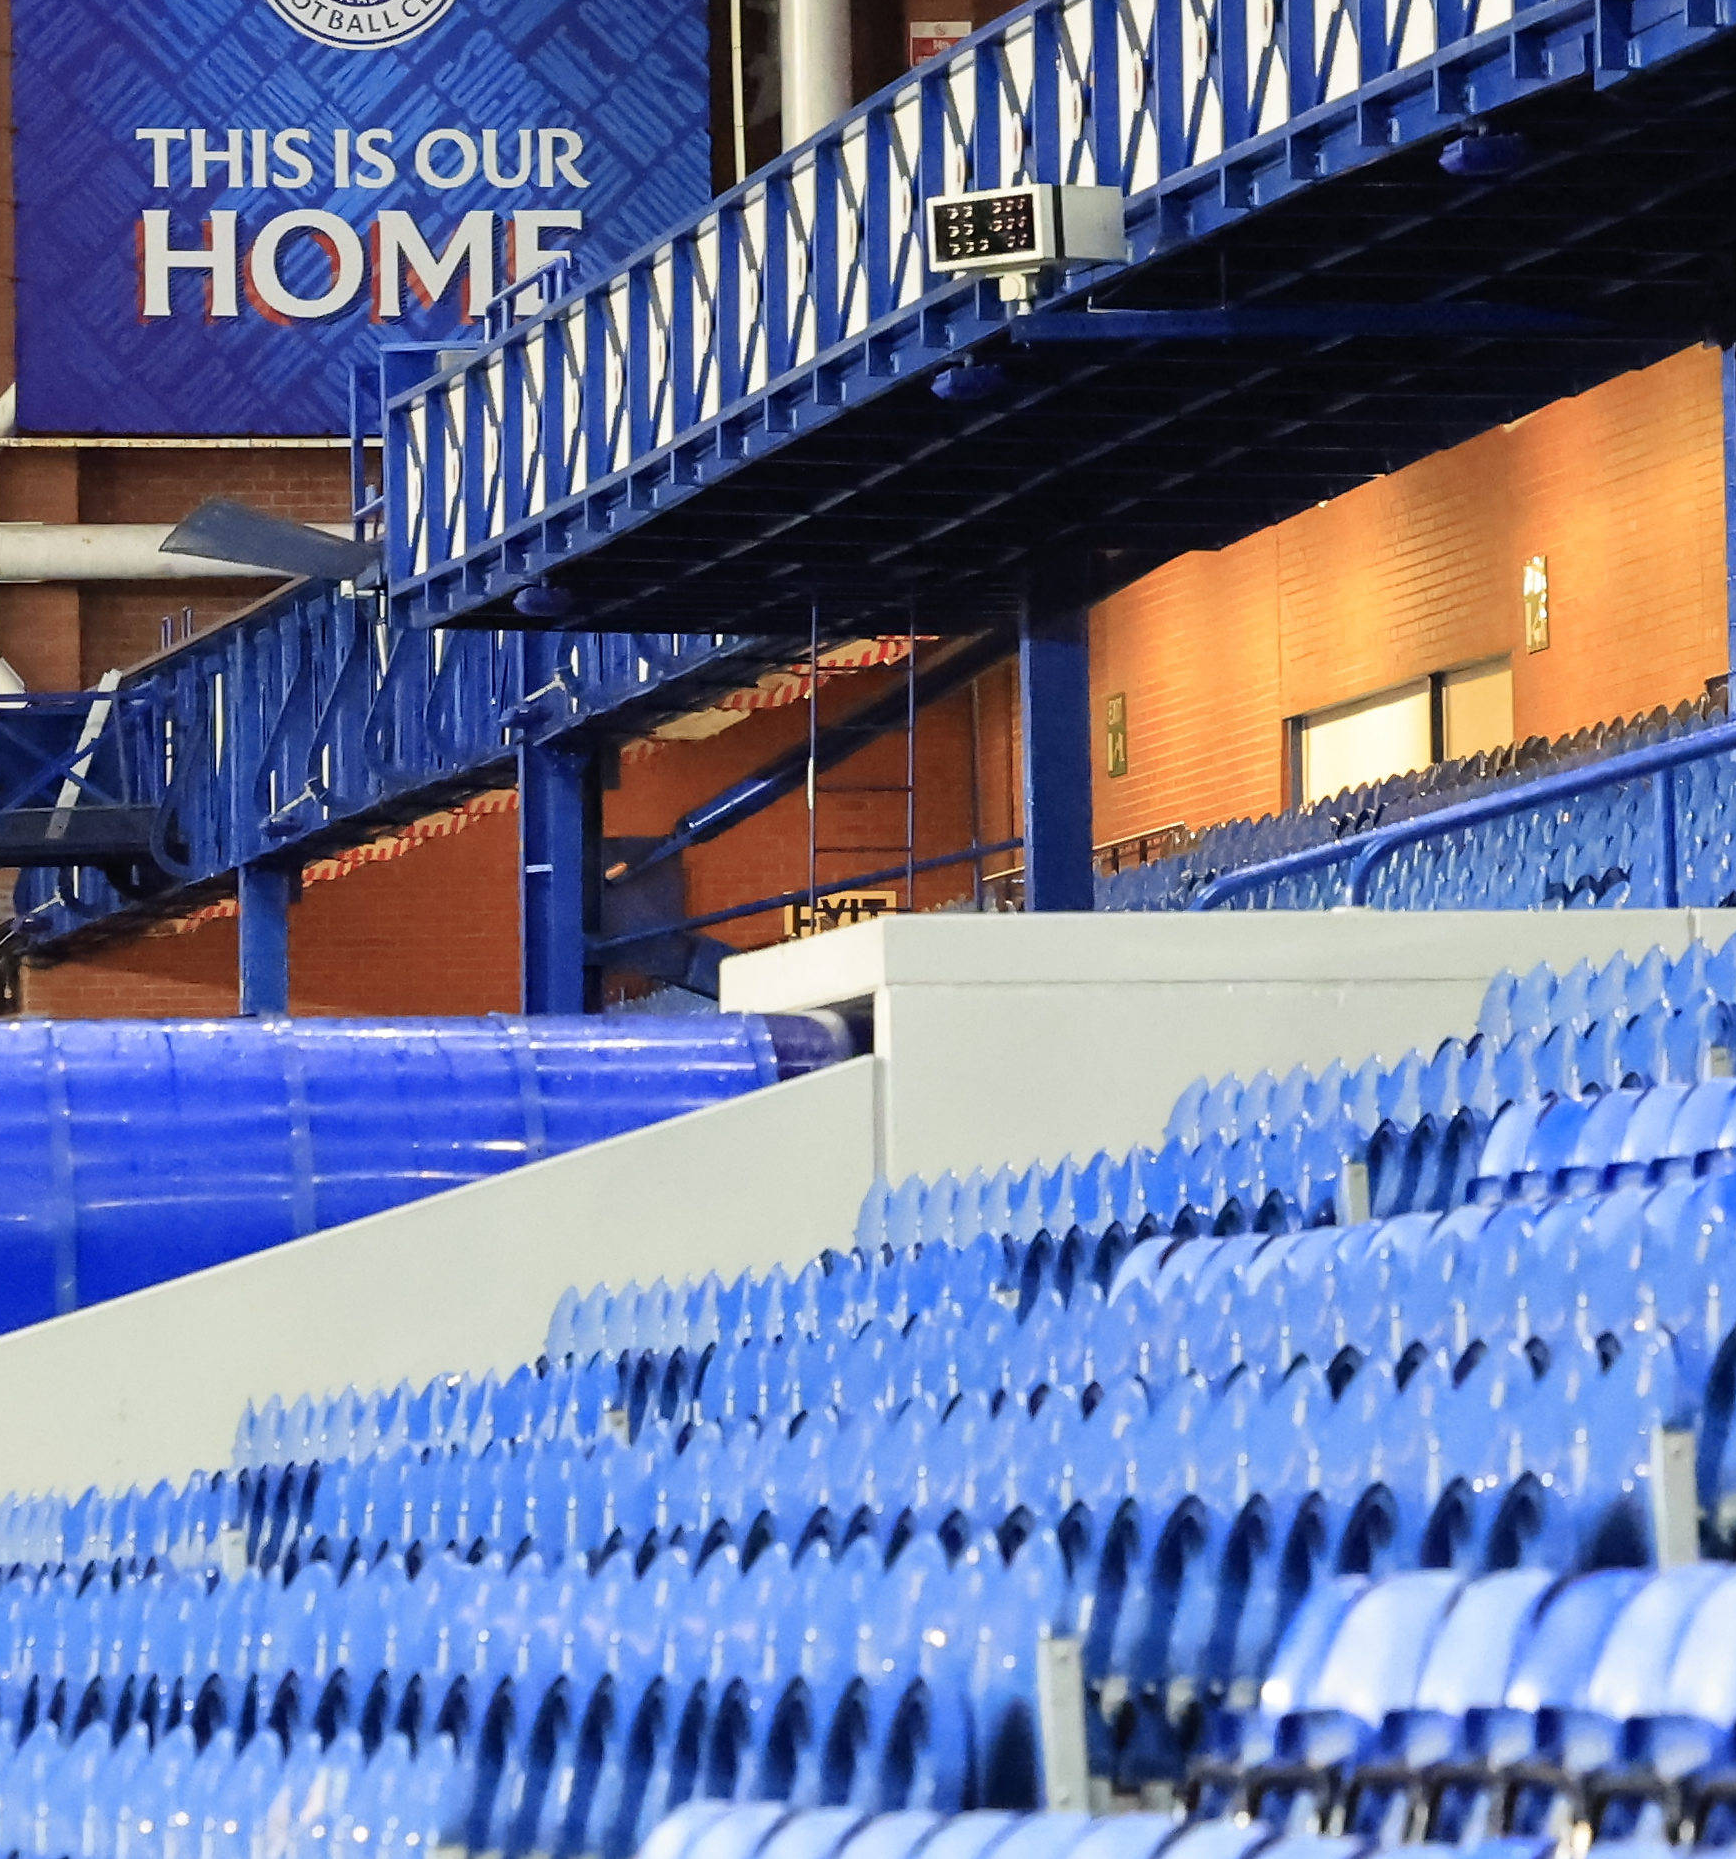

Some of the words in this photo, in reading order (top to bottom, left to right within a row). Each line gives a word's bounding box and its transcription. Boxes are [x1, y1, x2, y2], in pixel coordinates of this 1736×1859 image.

[135, 127, 311, 189] THIS
[334, 127, 396, 190] IS
[415, 127, 592, 190] OUR
[138, 208, 583, 319] HOME
